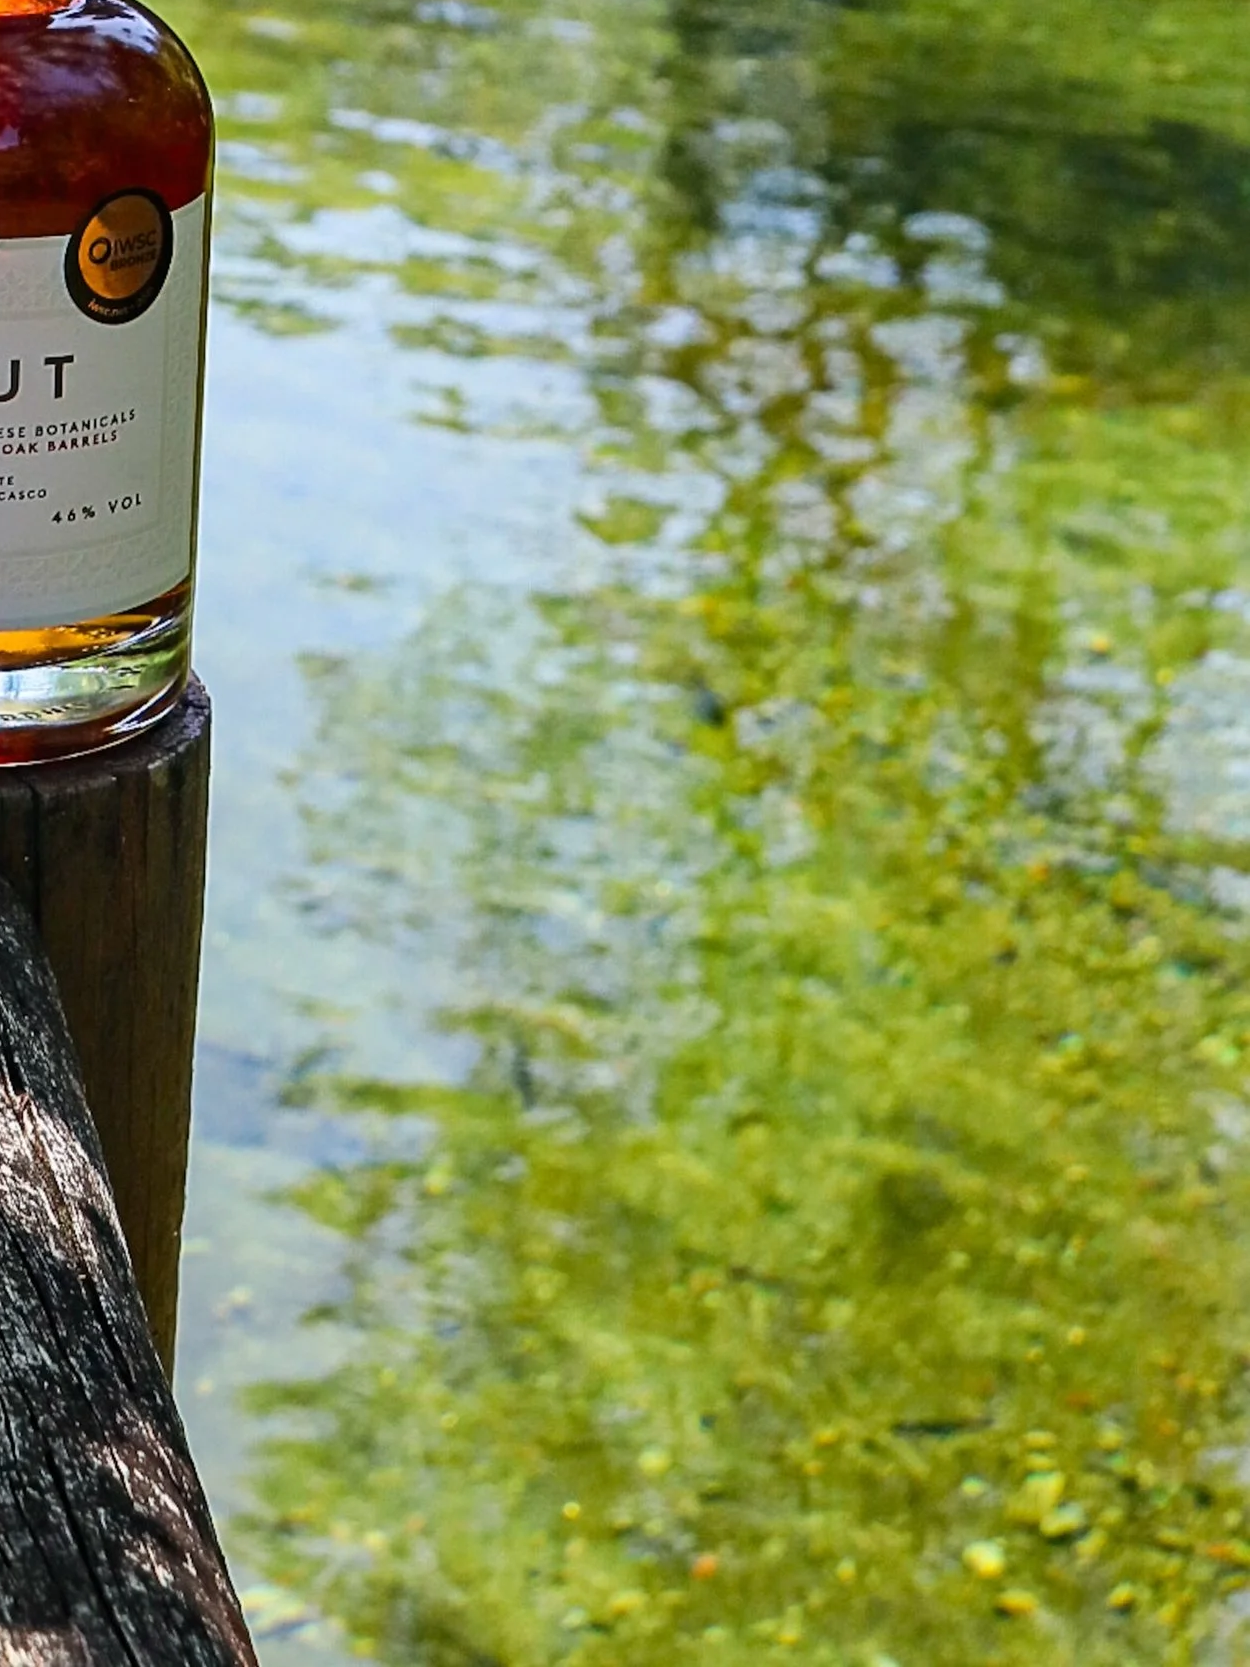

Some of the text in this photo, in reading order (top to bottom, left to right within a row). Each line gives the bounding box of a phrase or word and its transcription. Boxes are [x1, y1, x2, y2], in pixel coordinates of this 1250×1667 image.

[114, 230, 157, 256] IWSC
[35, 408, 136, 437] BOTANICALS
[2, 442, 38, 455] OAK
[47, 430, 118, 452] BARRELS
[52, 493, 142, 524] 46% VOL
